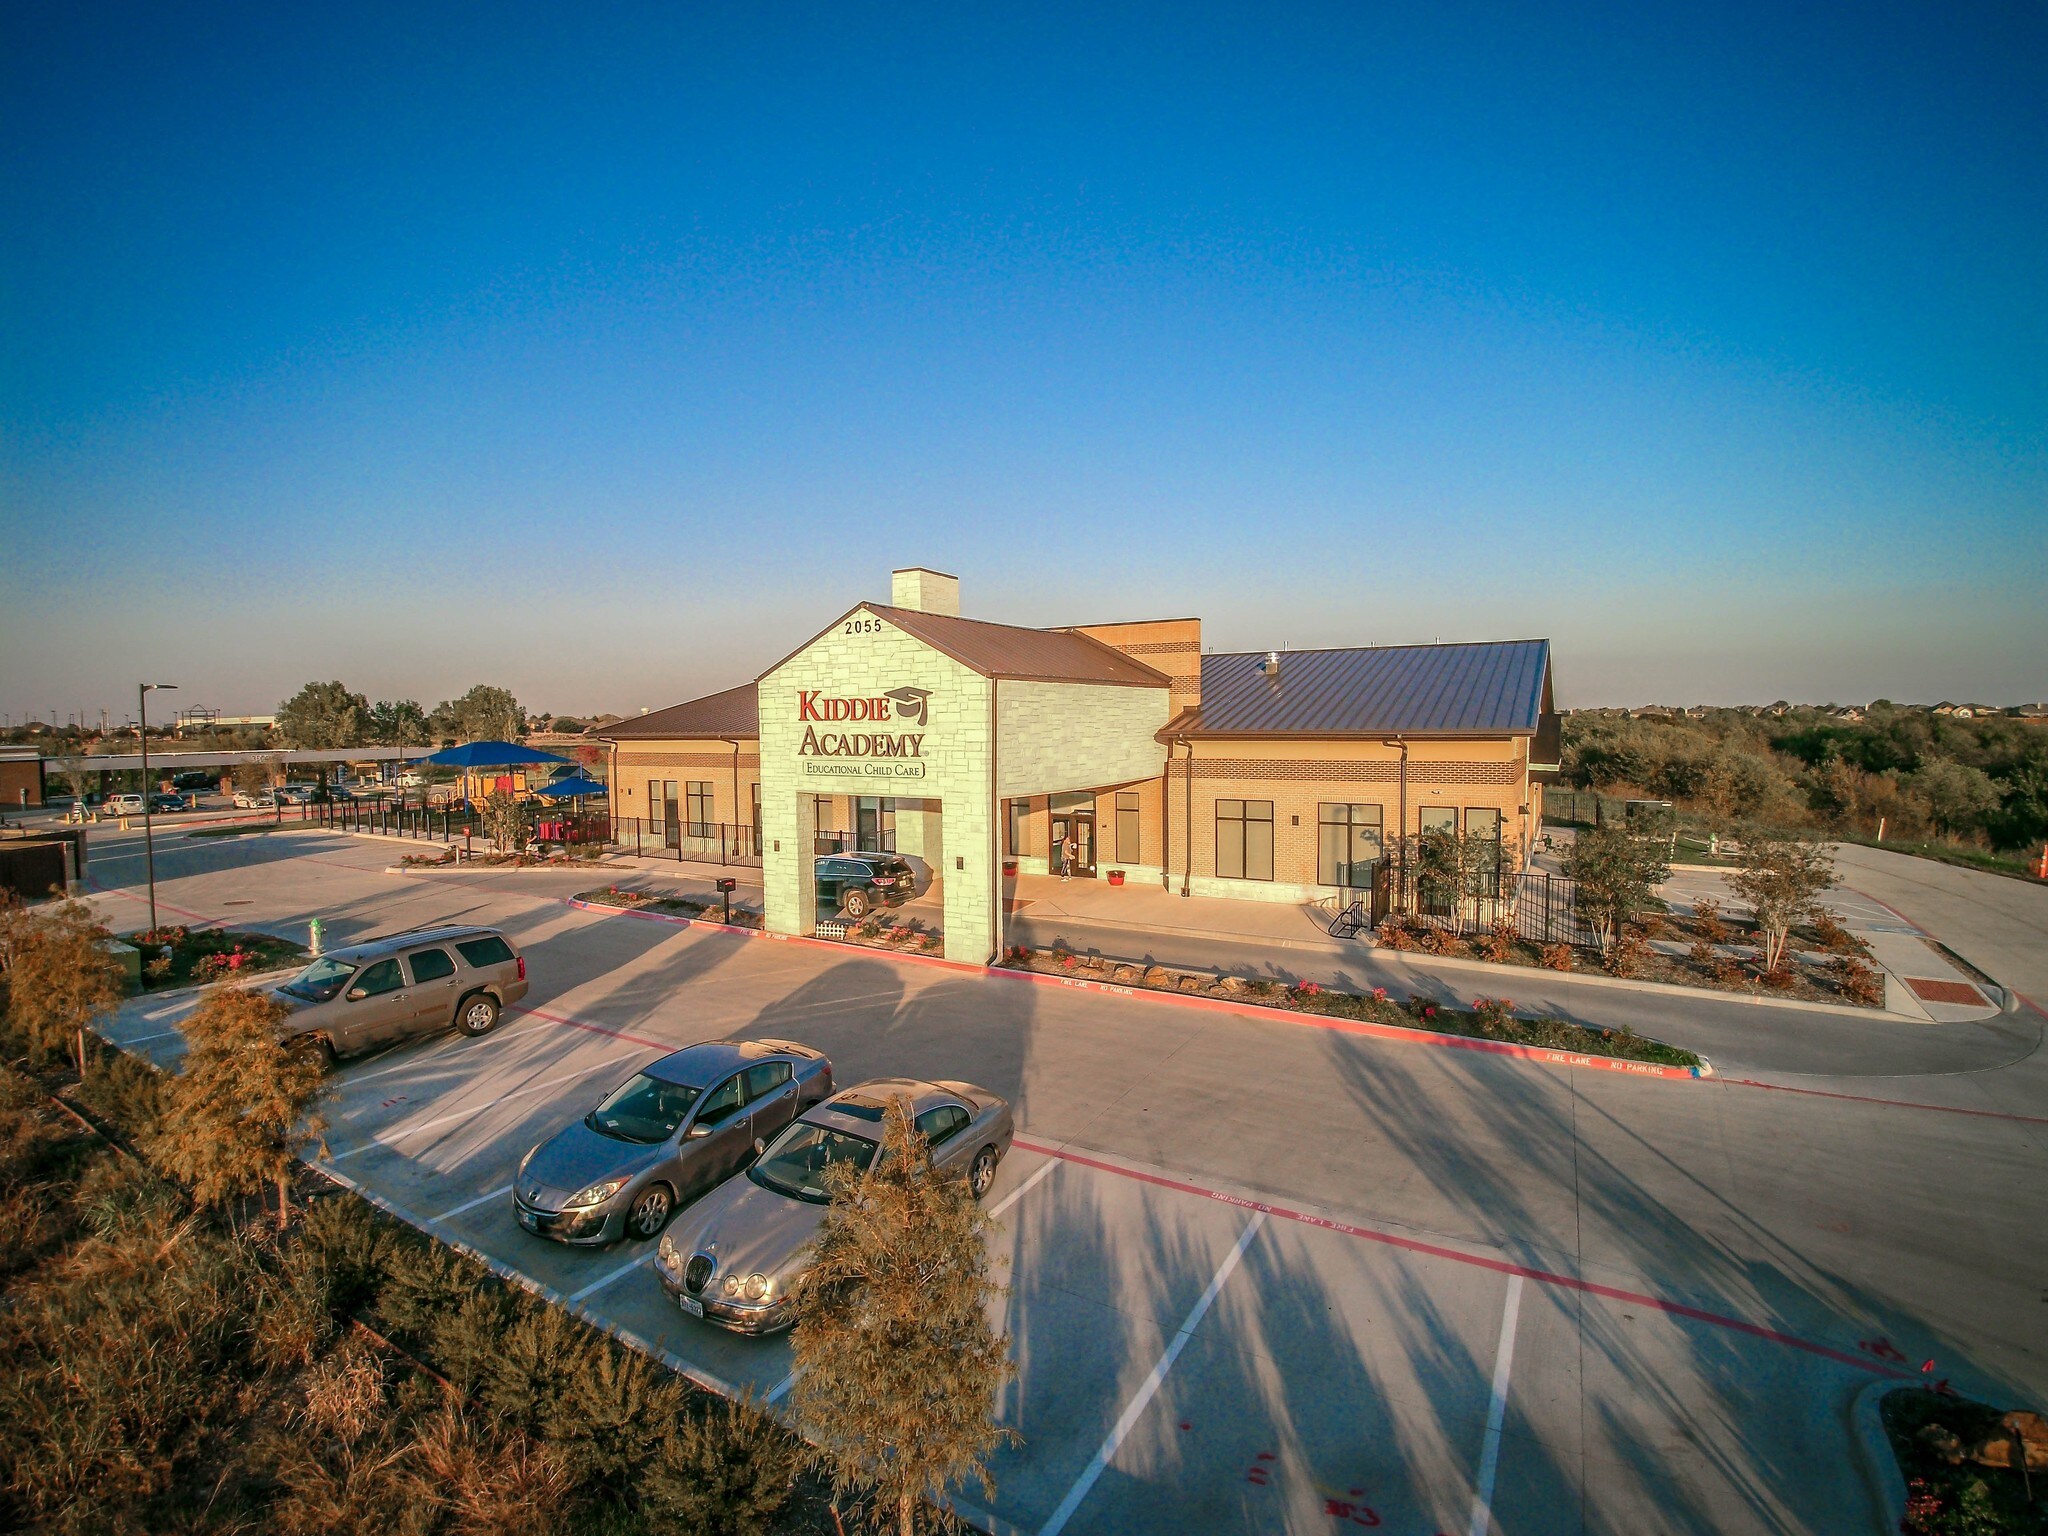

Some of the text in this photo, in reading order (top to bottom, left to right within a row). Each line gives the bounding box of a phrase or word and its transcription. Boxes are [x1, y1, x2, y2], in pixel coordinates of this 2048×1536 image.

[845, 619, 881, 634] 2055
[797, 690, 892, 721] KIDDIE
[798, 725, 925, 757] ACADEMY
[806, 762, 920, 776] EDUCATIONAL CHILD CARE
[1074, 980, 1088, 988] LANE
[1110, 986, 1133, 995] PARKING
[1546, 1052, 1663, 1076] FIRE LANE NO PARKING
[1211, 1192, 1354, 1233] FIRE LANE NO PARKING
